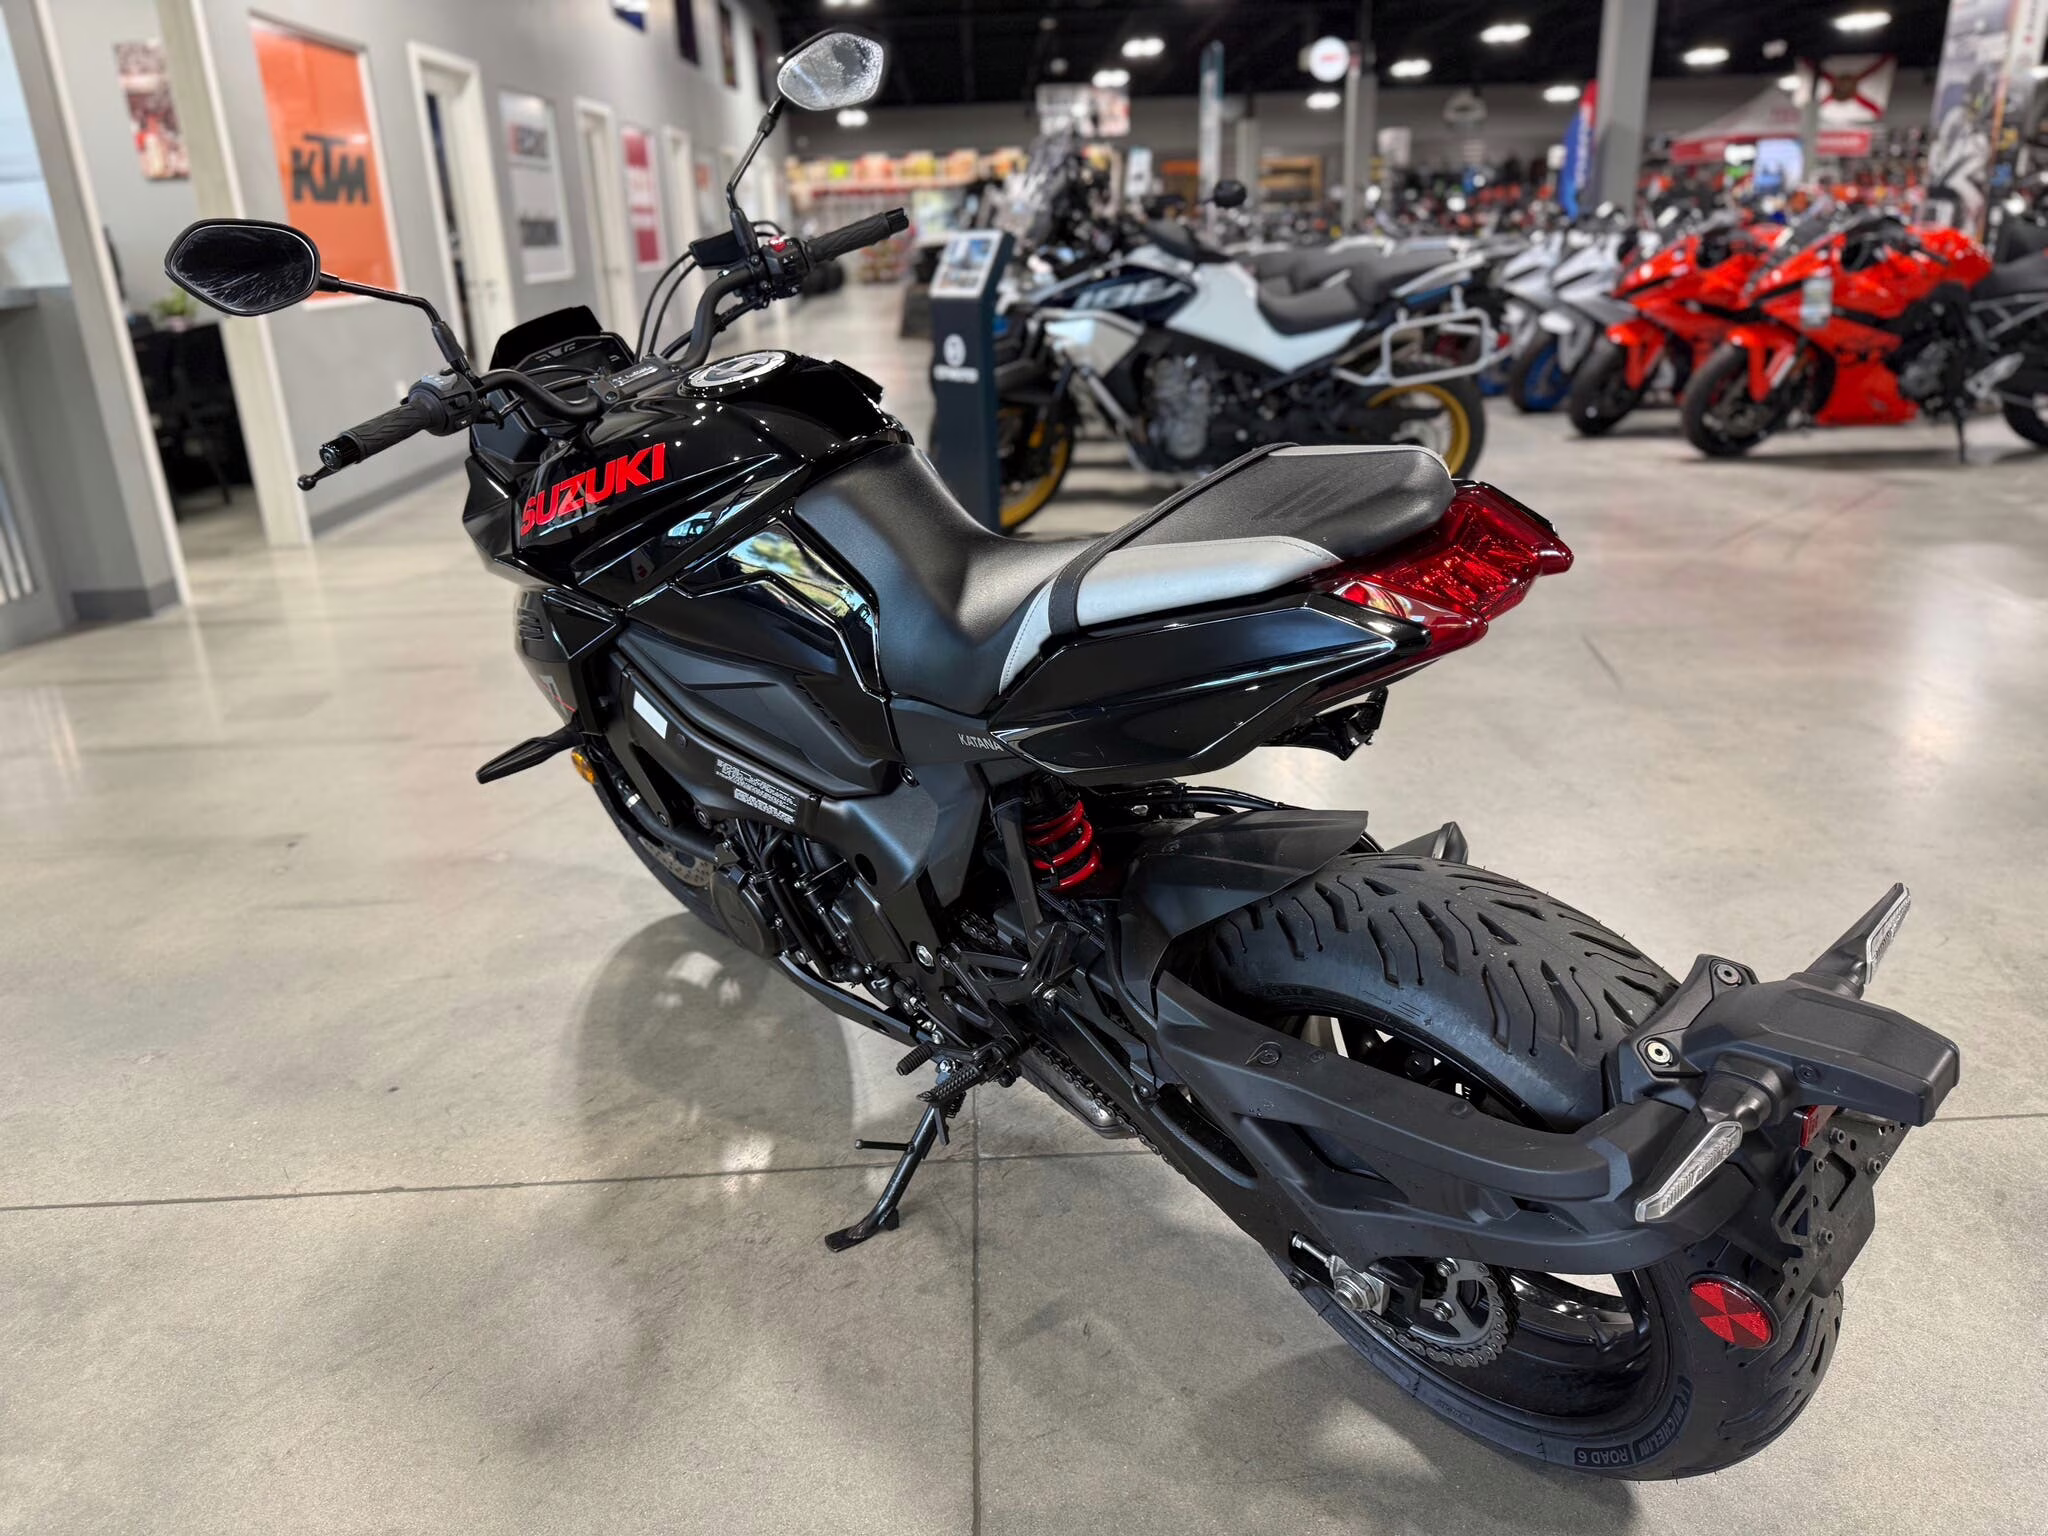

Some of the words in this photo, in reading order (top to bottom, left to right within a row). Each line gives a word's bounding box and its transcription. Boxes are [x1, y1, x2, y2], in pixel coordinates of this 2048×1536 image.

[291, 133, 370, 204] KTM
[520, 442, 666, 536] SUZUKI
[957, 732, 1004, 752] KATANA
[1638, 1398, 1686, 1457] MICHELIN
[1578, 1451, 1587, 1463] 6
[1591, 1448, 1628, 1464] ROAD
